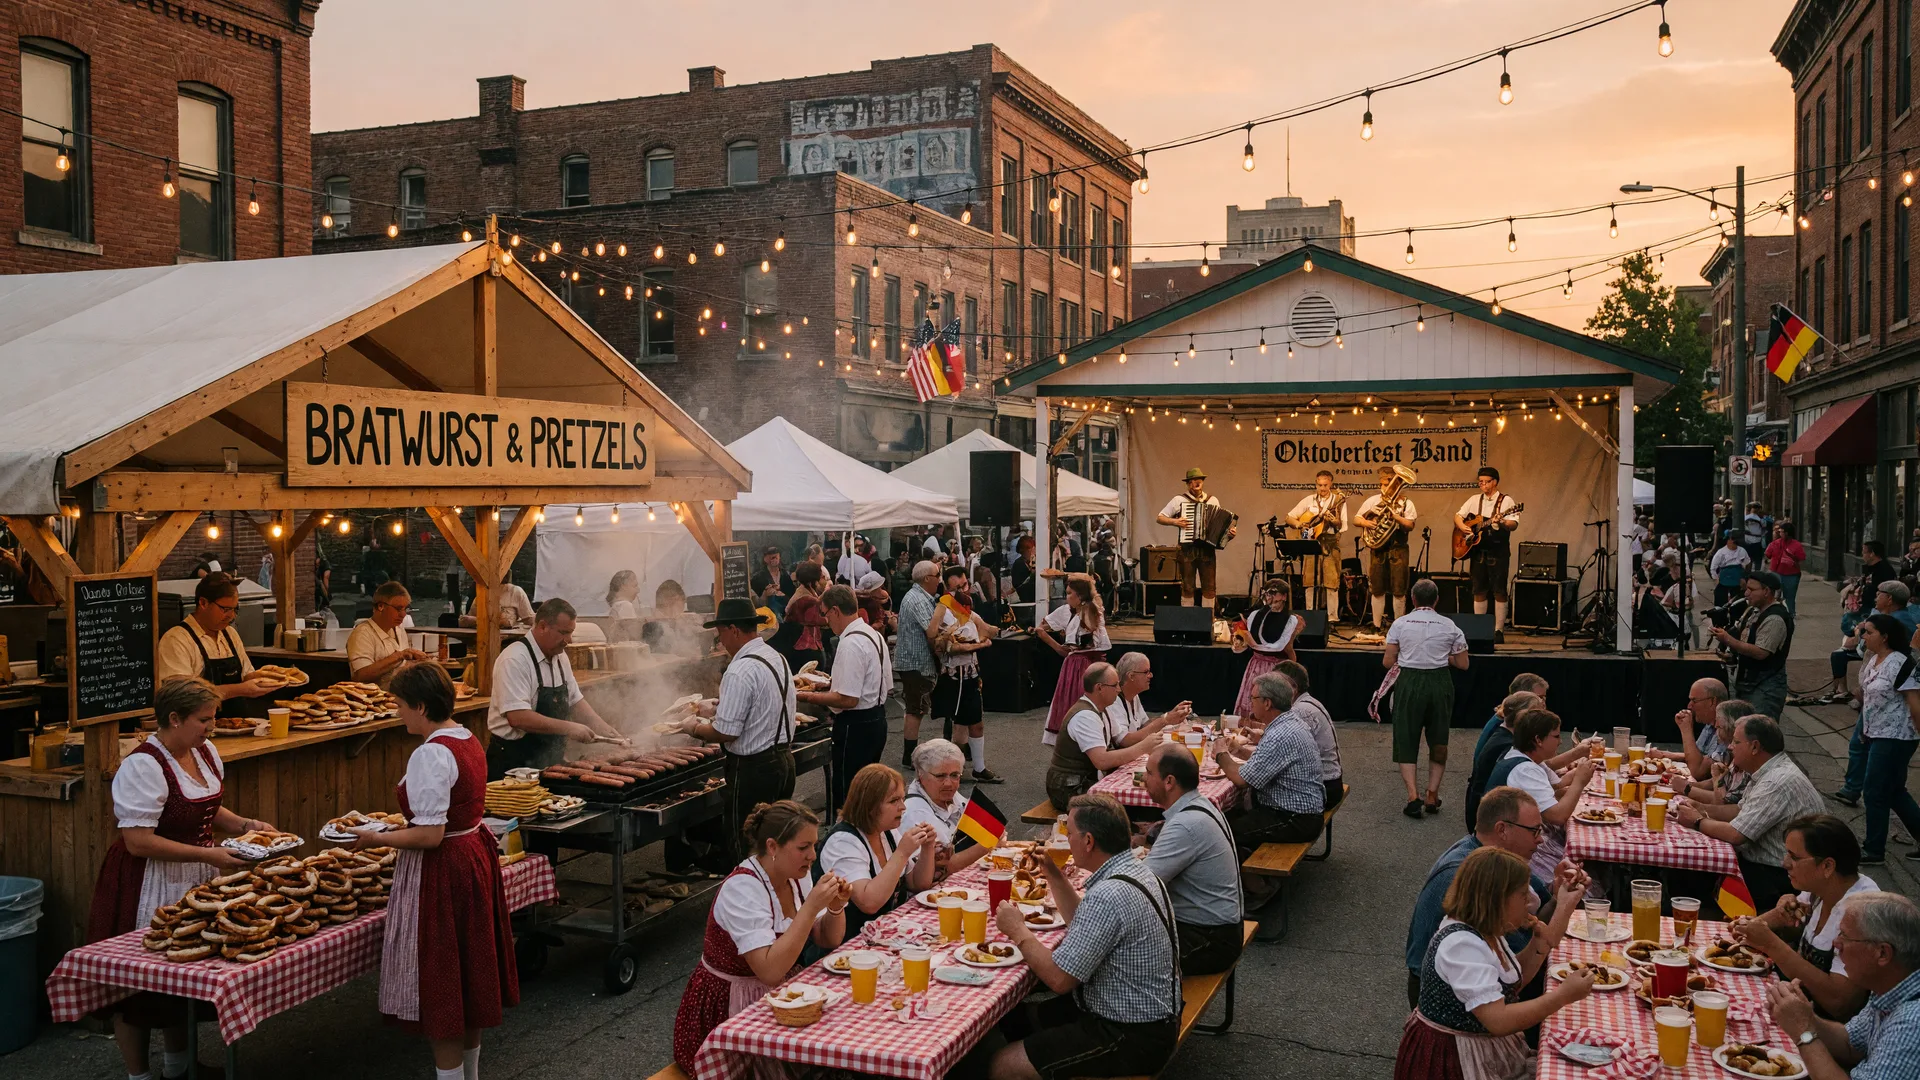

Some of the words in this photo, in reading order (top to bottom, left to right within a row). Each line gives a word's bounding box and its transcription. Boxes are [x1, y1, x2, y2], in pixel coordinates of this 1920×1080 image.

[306, 402, 499, 468] BRATWURST
[506, 422, 523, 464] &
[530, 416, 647, 471] PRETZELS
[1274, 438, 1402, 464] Oktoberfest
[1411, 437, 1473, 465] Band
